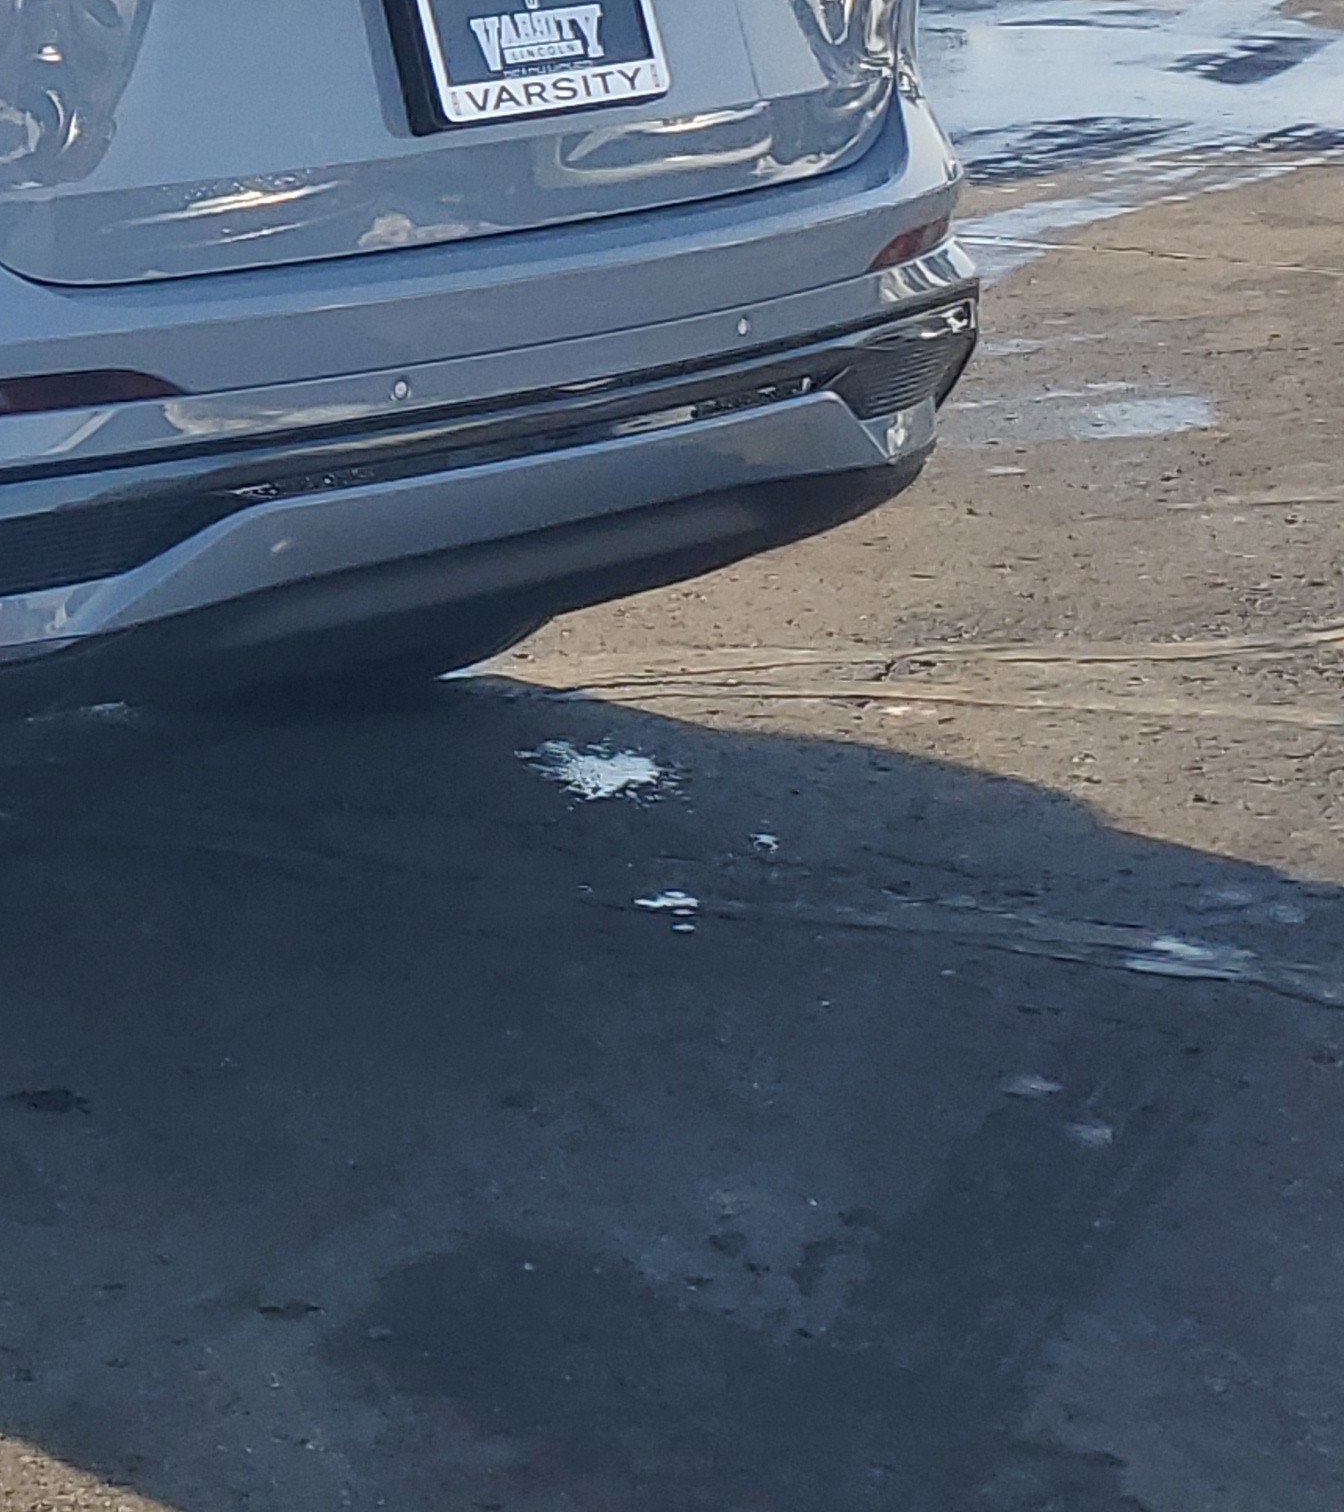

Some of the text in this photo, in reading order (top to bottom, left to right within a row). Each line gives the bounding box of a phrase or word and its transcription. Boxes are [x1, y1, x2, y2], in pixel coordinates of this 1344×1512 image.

[469, 3, 605, 73] VARSITY
[511, 43, 576, 62] LINCOLN
[465, 67, 642, 113] VARSITY
